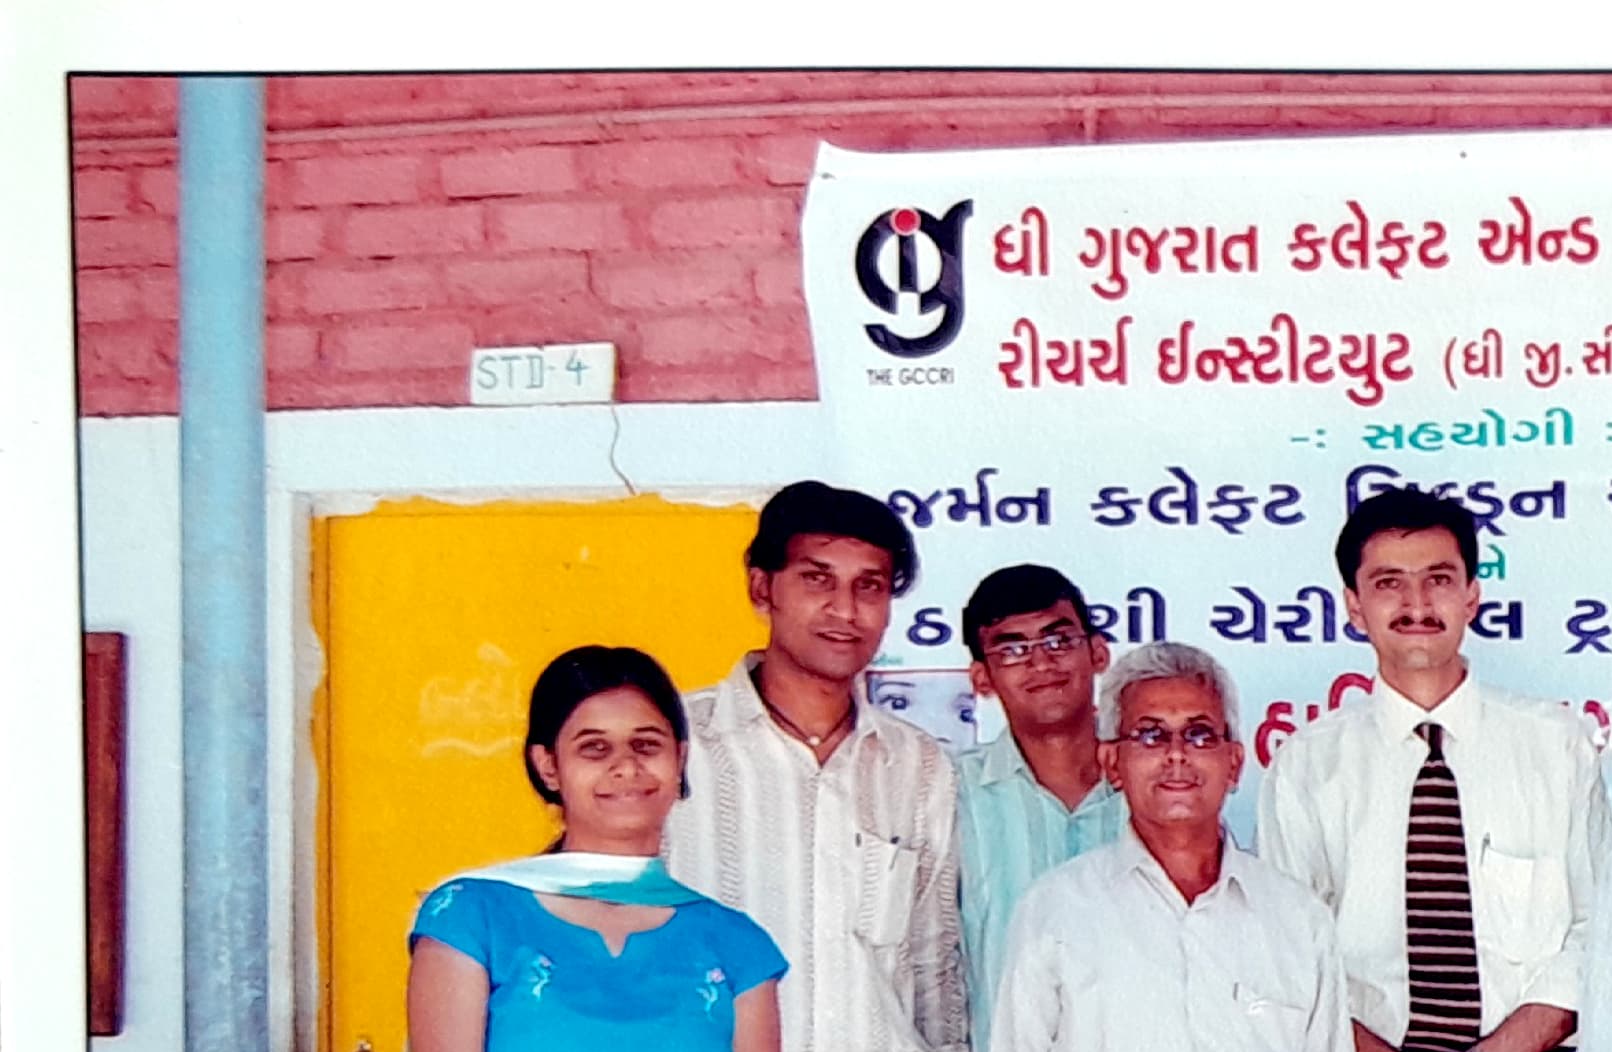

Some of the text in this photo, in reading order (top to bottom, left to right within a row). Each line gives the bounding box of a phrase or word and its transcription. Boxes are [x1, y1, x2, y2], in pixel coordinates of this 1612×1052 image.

[993, 206, 1048, 276] ધી
[1079, 225, 1258, 300] ગુજરાત
[1288, 200, 1449, 280] કલેફટ
[1478, 196, 1599, 265] એન્ડ
[864, 365, 955, 386] THE GCCRI
[998, 315, 1133, 389] રીચર્ચ
[1361, 409, 1574, 452] સહયોગી
[1090, 466, 1306, 535] કલેફટ
